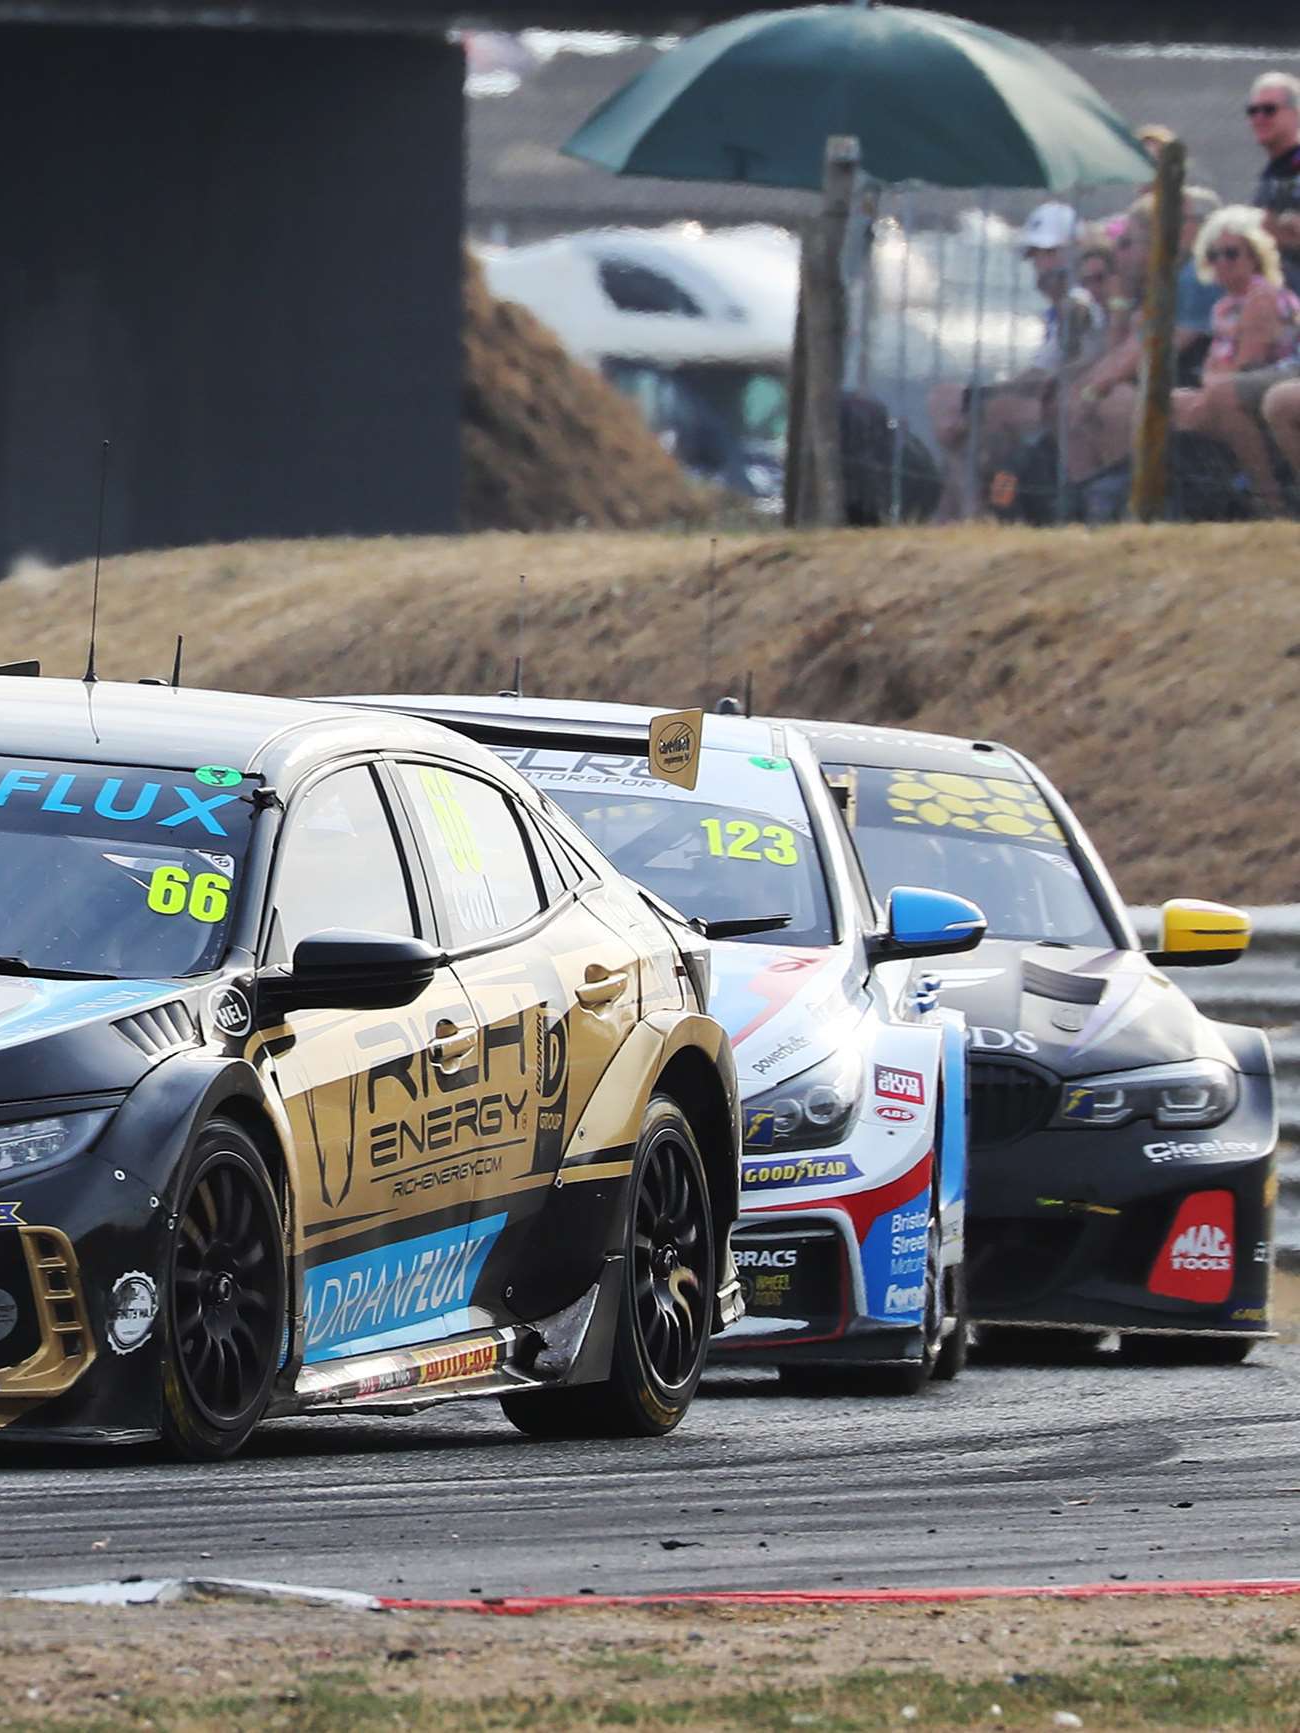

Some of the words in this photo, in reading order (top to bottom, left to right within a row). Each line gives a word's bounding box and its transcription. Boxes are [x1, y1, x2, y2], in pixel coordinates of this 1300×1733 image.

[701, 818, 799, 866] 123
[147, 866, 230, 923] 66
[217, 1003, 247, 1028] HEL
[355, 993, 526, 1114] RICH
[370, 1089, 528, 1168] ENERGY
[744, 1161, 848, 1185] GOODYEAR
[891, 1234, 928, 1255] Stree
[1170, 1257, 1232, 1271] TOOLS
